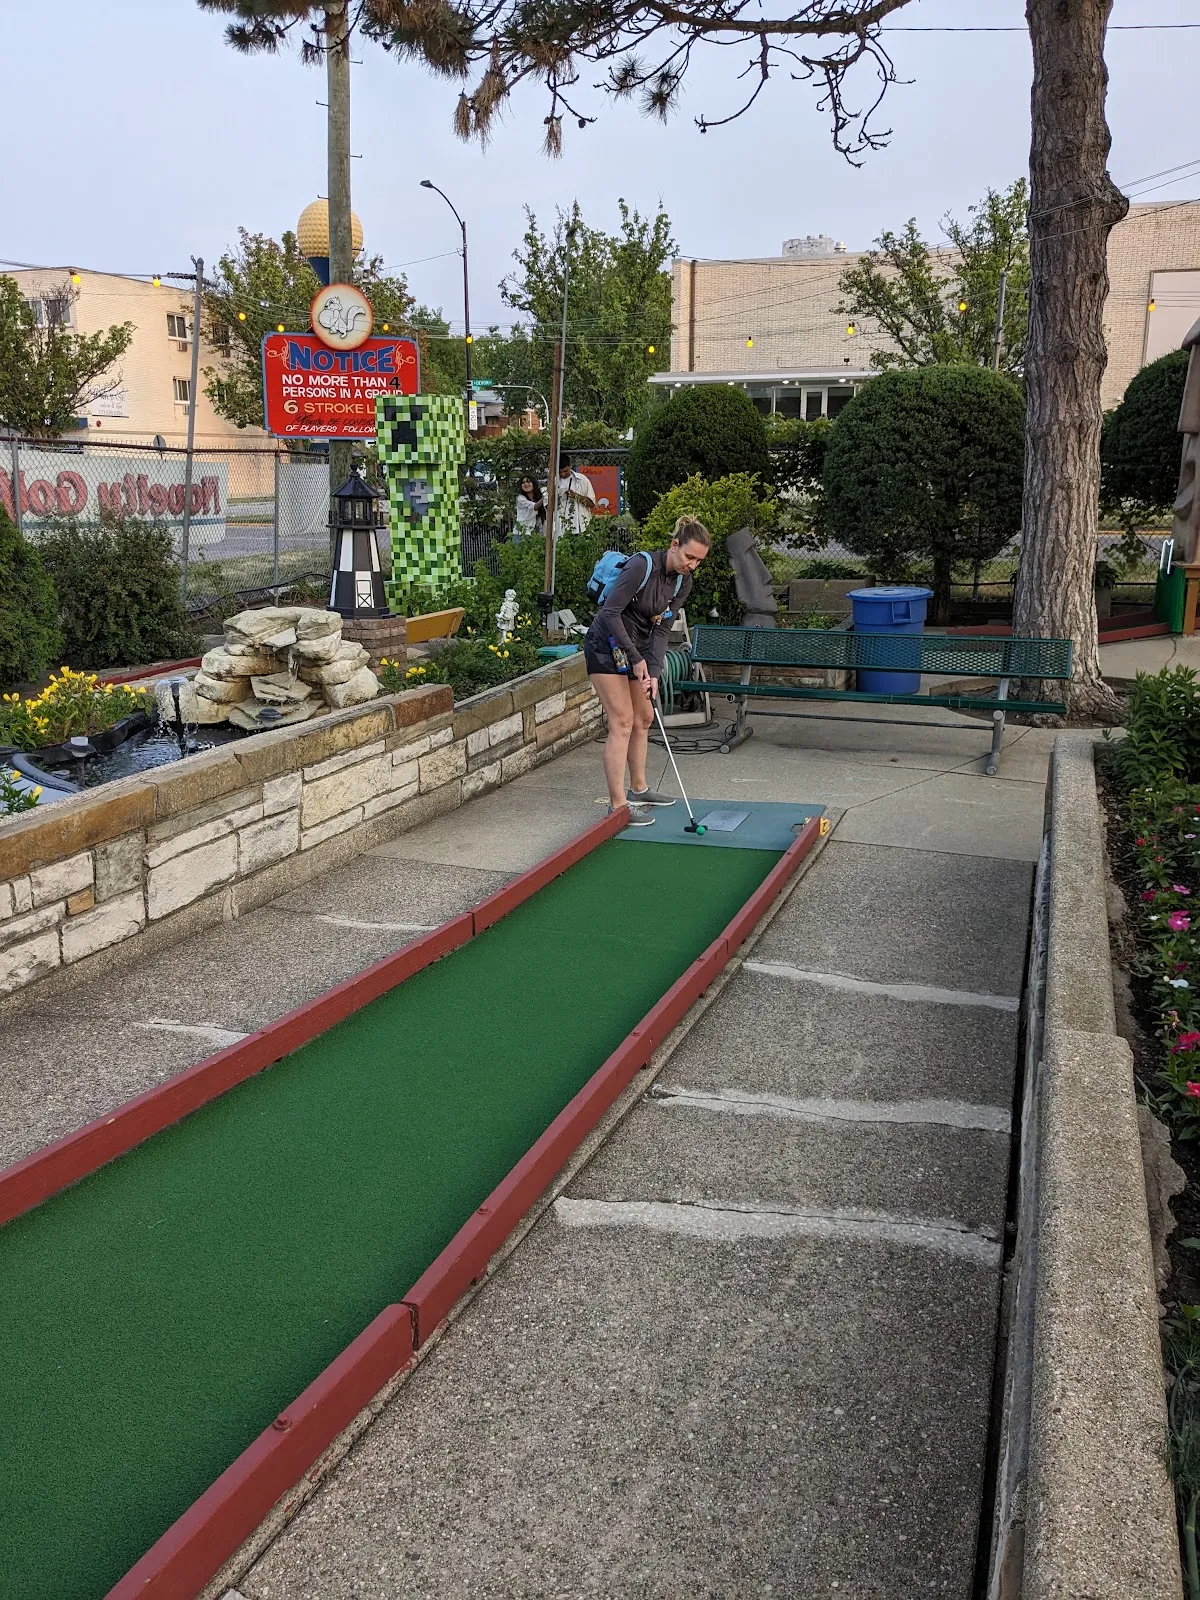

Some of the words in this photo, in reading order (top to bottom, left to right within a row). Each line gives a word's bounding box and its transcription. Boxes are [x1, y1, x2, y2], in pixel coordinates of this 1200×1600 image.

[288, 341, 396, 373] NOTICE
[282, 375, 303, 385] NO
[308, 376, 349, 387] MORE
[351, 377, 387, 388] THAN
[388, 376, 400, 390] 4
[282, 387, 337, 398] PERSONS
[340, 388, 351, 399] IN
[354, 388, 363, 399] A
[283, 400, 299, 414] 6
[304, 403, 364, 414] STROKE
[285, 425, 299, 433] OF
[299, 425, 337, 433] PLAYERS
